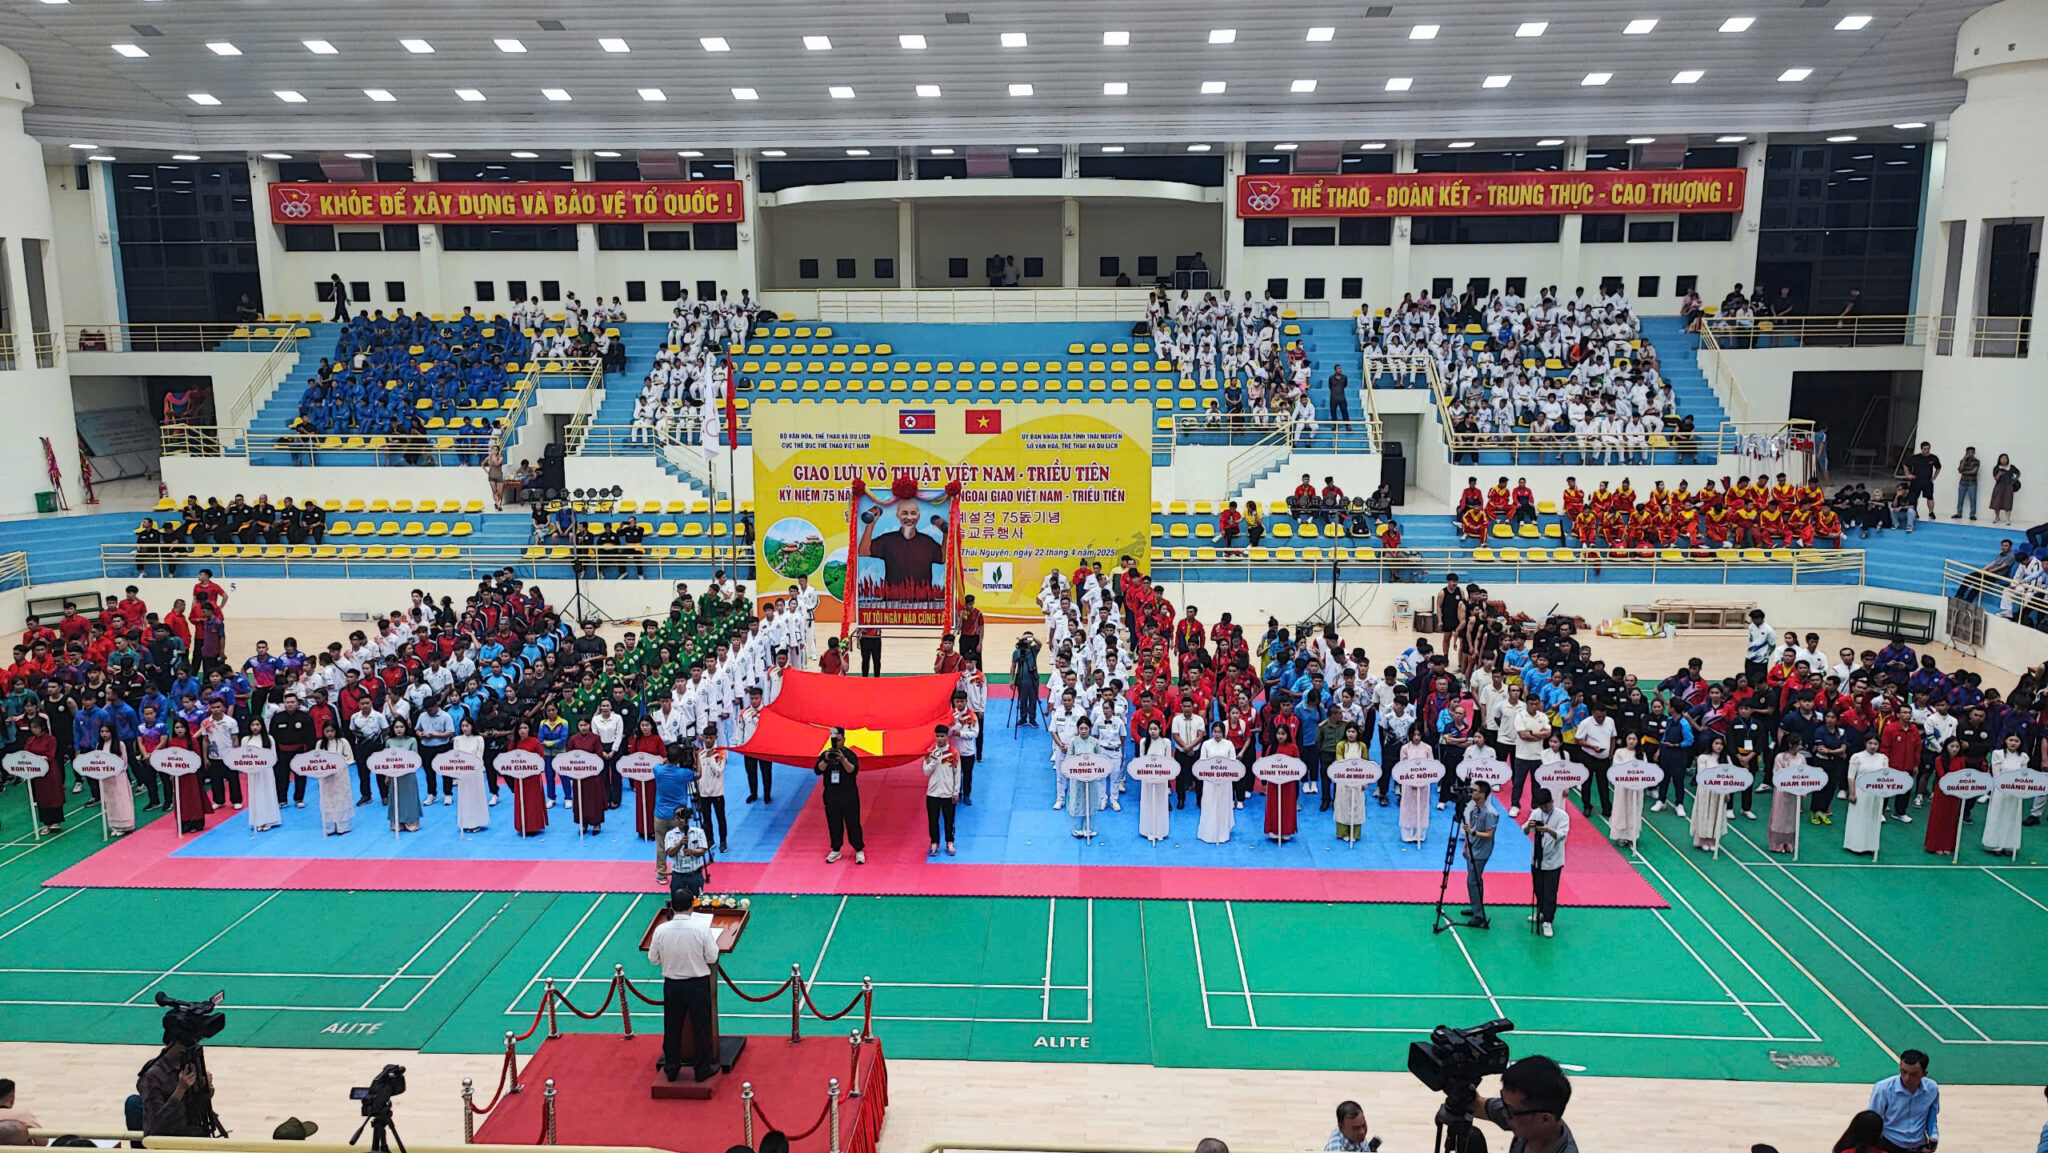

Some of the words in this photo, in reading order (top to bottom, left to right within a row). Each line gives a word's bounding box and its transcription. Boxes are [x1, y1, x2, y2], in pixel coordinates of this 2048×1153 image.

[320, 188, 374, 216] KHỎE
[380, 187, 406, 215] ĐỂ
[411, 192, 452, 215] XÂY
[459, 192, 513, 220] DỰNG
[521, 190, 549, 214] VÀ
[554, 187, 595, 214] BẢO
[601, 189, 627, 218] VỆ
[632, 186, 657, 214] TỔ
[663, 186, 719, 214] QUỐC
[1291, 179, 1323, 208] THỂ
[1327, 186, 1371, 207] THAO
[1386, 182, 1434, 207] ĐOÀN
[1438, 178, 1470, 206] KẾT
[1487, 183, 1544, 206] TRUNG
[1549, 183, 1594, 209] THỰC
[1612, 183, 1648, 204] CAO
[1652, 180, 1721, 208] THƯỢNG
[794, 466, 829, 480] GIAO
[834, 464, 862, 480] LƯU
[867, 462, 888, 480] VÕ
[891, 463, 940, 485] THUẬT
[945, 463, 978, 485] VIỆT
[982, 467, 1015, 482] NAM
[1027, 459, 1071, 482] TRIỀU
[1076, 462, 1110, 482] TIÊN
[780, 486, 791, 501] KỶ
[795, 487, 820, 504] NIỆM
[823, 490, 834, 502] 75
[959, 490, 988, 504] NGOẠI
[991, 490, 1013, 502] GIAO
[1016, 488, 1037, 504] VIỆT
[1040, 490, 1062, 502] NAM
[1103, 488, 1124, 502] TIÊN
[320, 1022, 384, 1034] ALITE
[1033, 1036, 1090, 1048] ALITE
